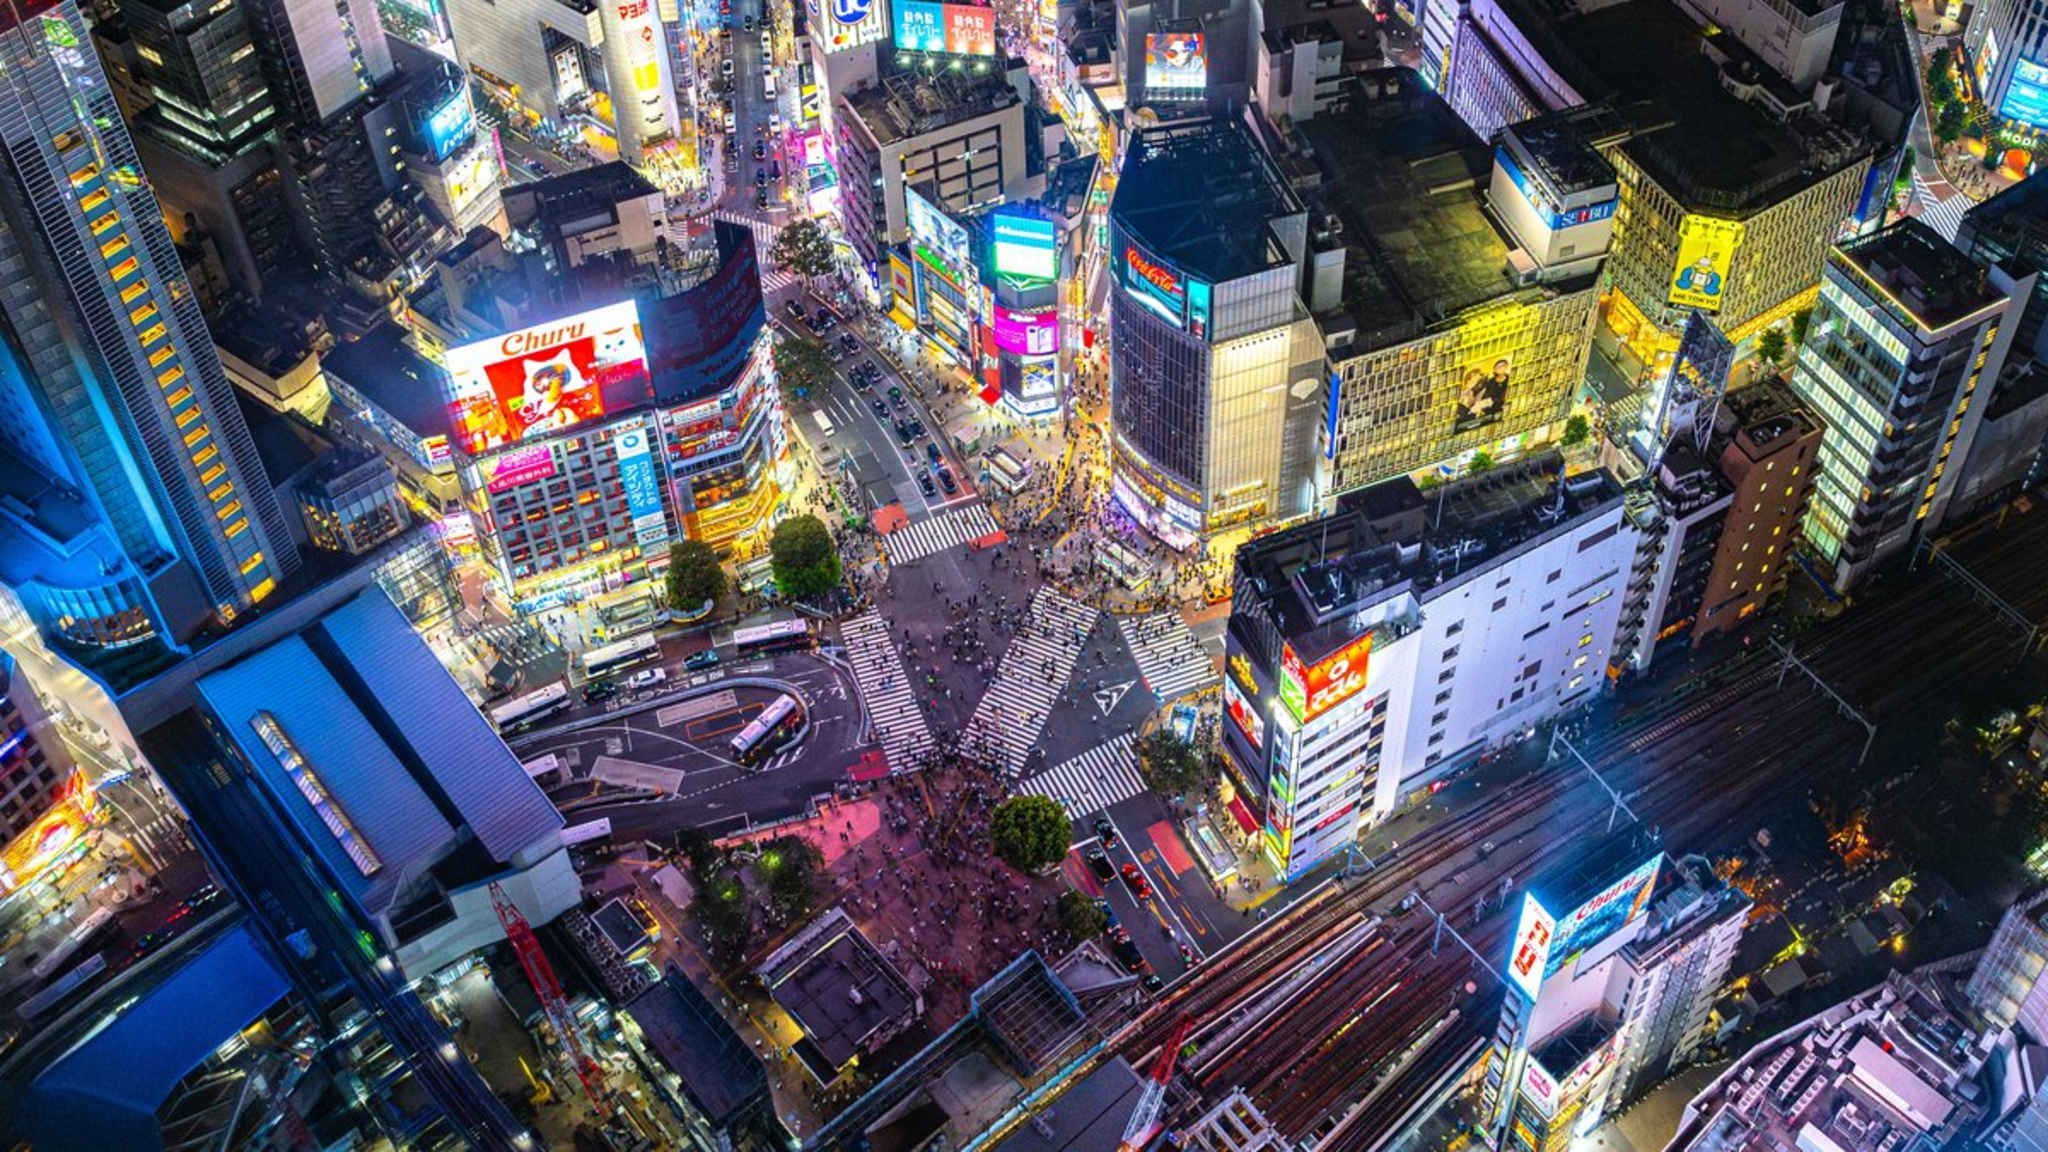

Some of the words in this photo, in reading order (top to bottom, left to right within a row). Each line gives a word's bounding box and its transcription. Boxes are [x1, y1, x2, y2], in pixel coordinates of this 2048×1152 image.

[1561, 204, 1609, 228] SEIBU
[501, 322, 584, 356] Churu
[1576, 875, 1636, 921] Churu
